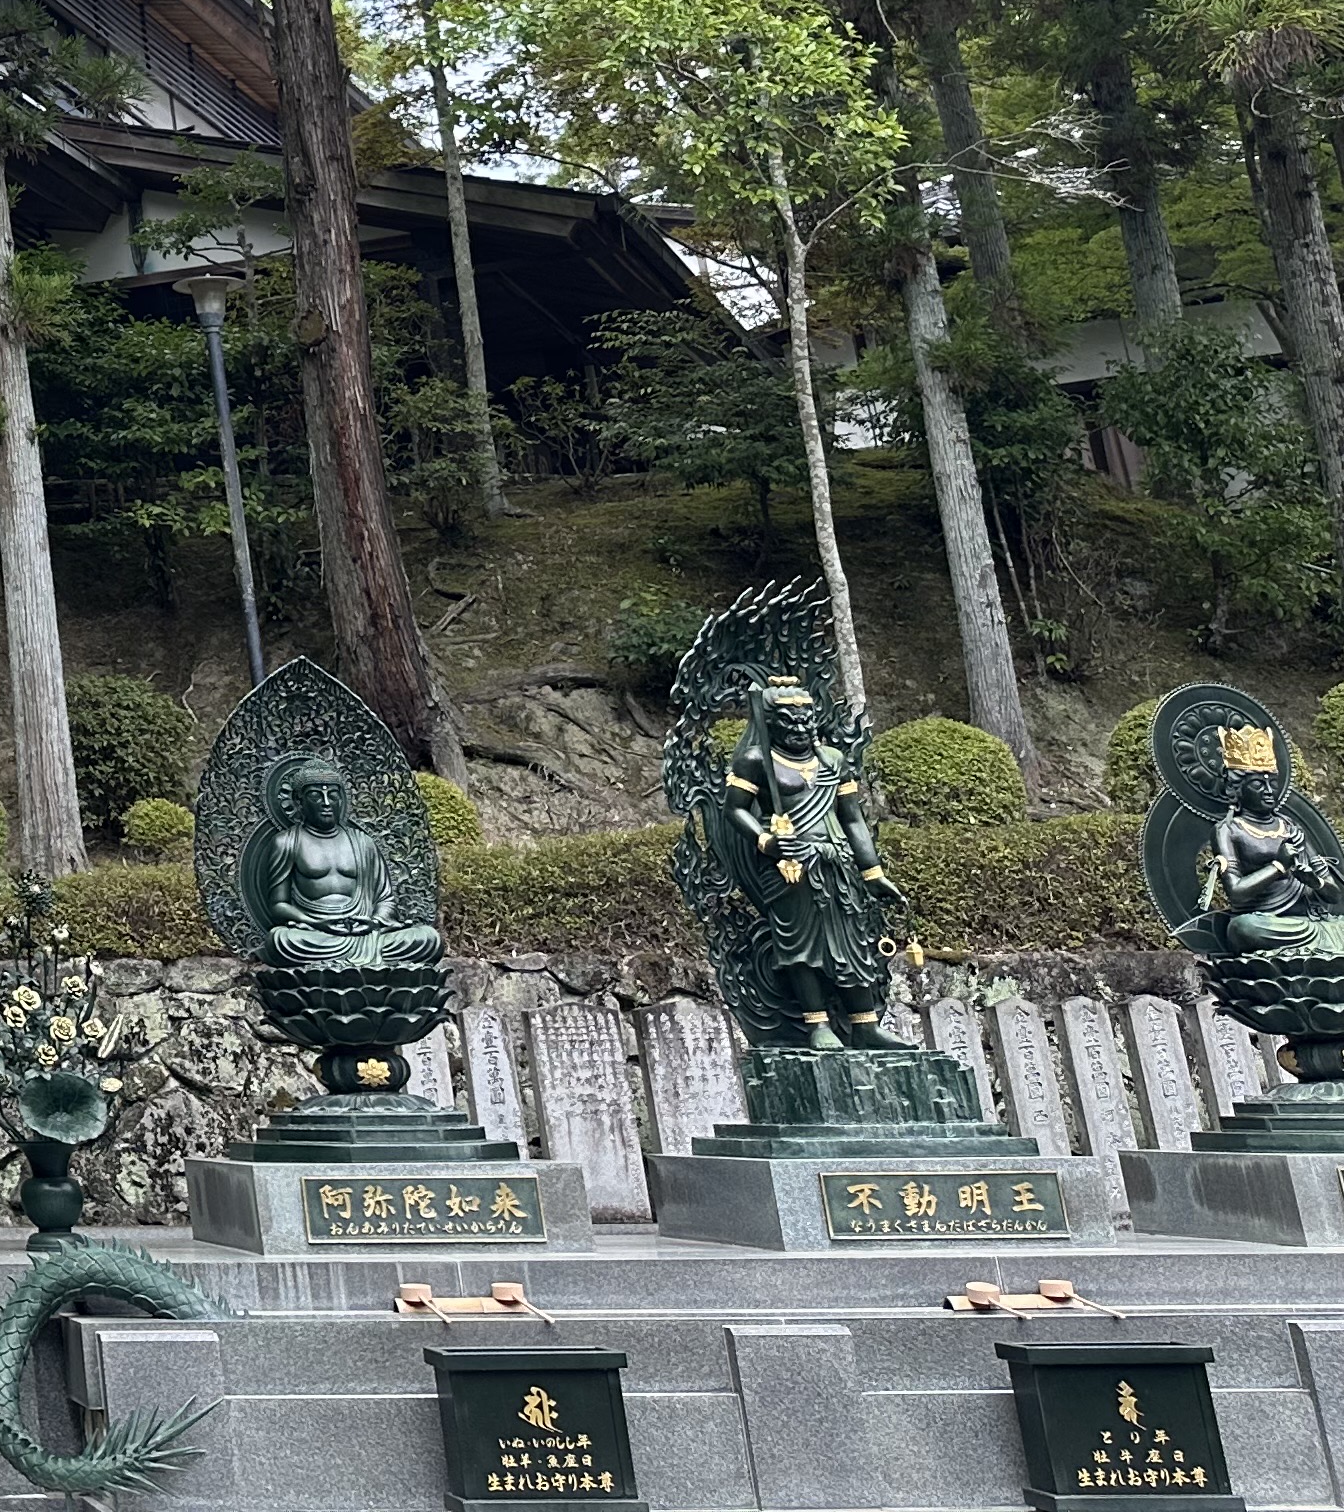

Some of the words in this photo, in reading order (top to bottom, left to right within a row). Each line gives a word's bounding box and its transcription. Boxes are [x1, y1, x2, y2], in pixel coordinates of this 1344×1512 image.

[318, 1181, 530, 1220] 阿弥陀如来
[846, 1180, 1045, 1217] 不動明王
[498, 1434, 592, 1450] いぬ・いのしし年
[1099, 1429, 1171, 1445] とり年
[1092, 1449, 1185, 1464] 牡牛座日
[487, 1471, 615, 1493] 生まれお守り本尊
[1077, 1466, 1209, 1488] 生まれお守り本尊
